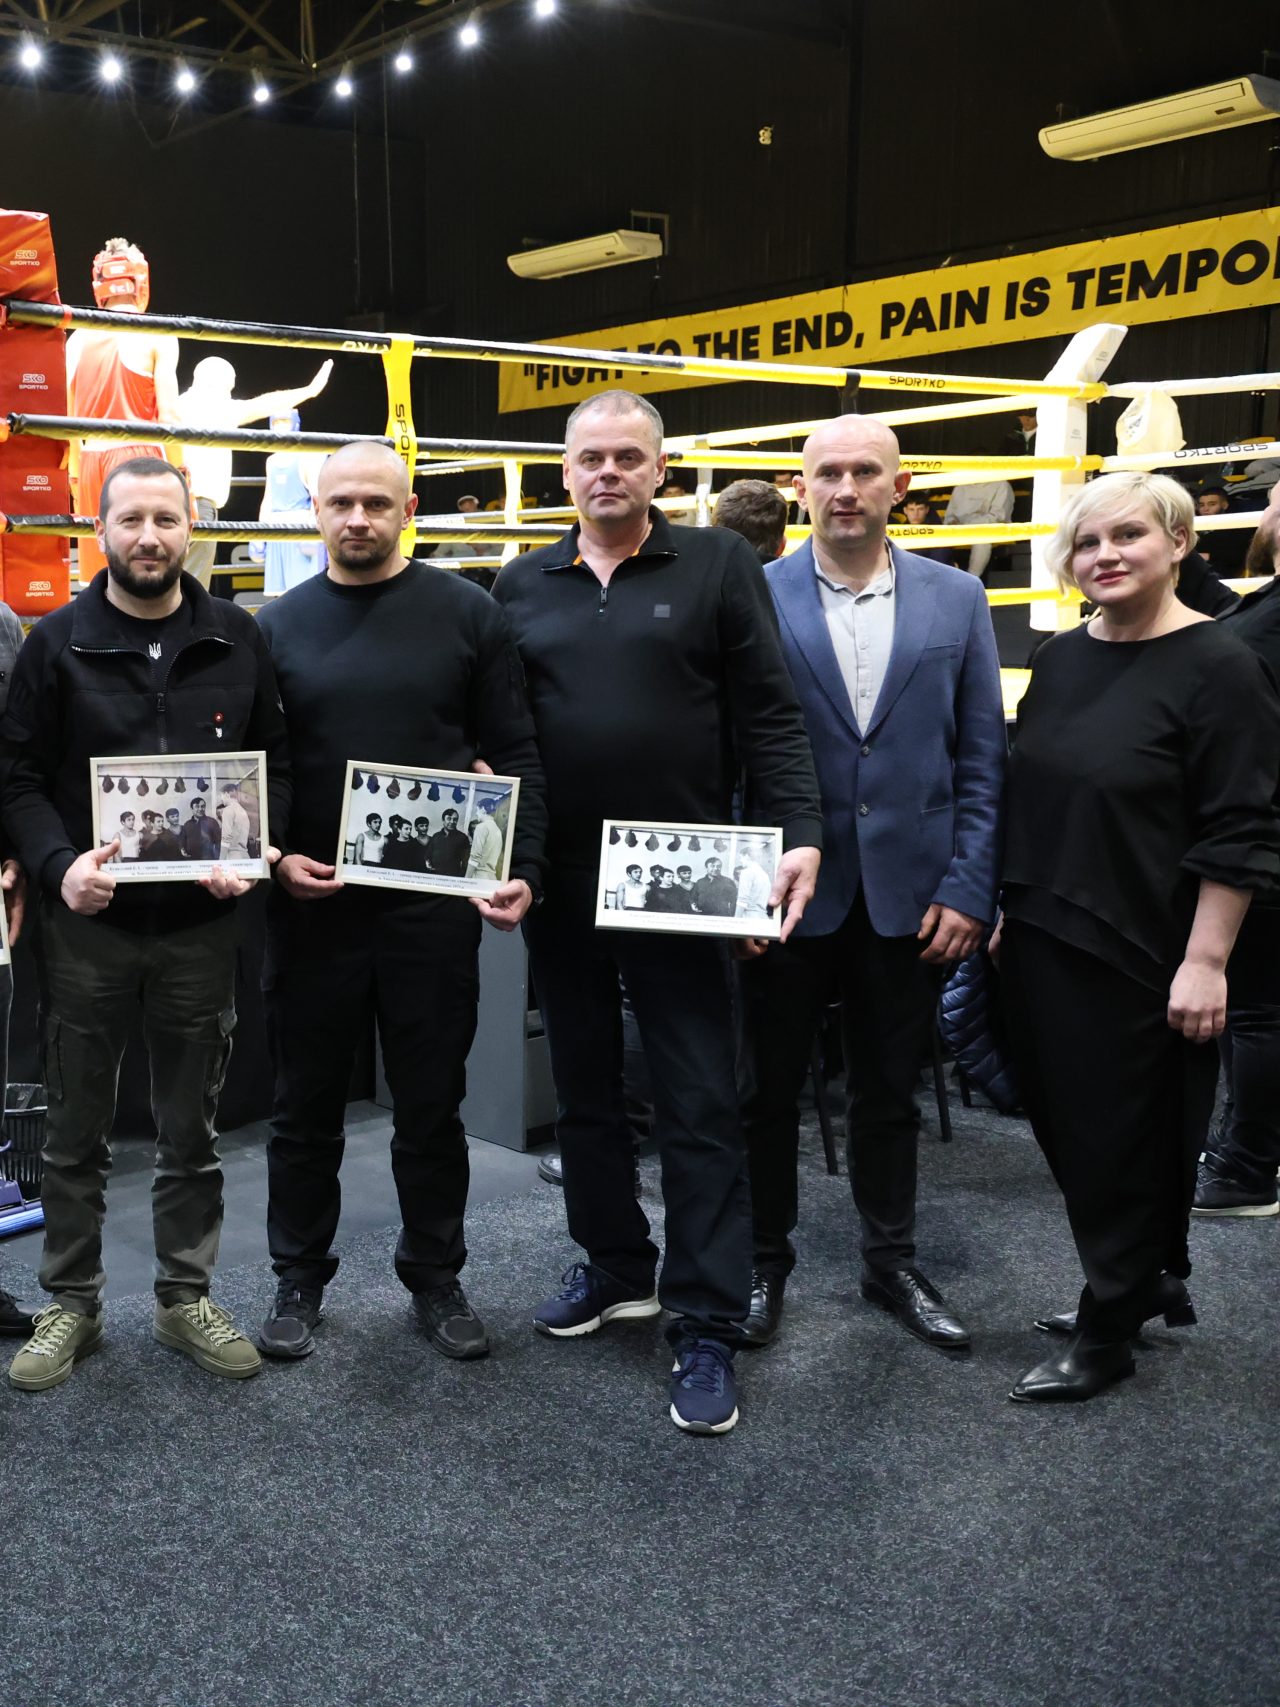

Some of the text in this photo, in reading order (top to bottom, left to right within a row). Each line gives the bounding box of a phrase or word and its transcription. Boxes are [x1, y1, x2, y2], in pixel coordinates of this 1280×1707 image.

[693, 325, 760, 362] THE
[773, 311, 864, 356] END,
[880, 285, 991, 340] PAIN
[1004, 276, 1051, 320] IS
[1067, 236, 1280, 310] TEMPO
[888, 375, 945, 388] SPORTKO
[1175, 443, 1268, 459] SPORTKO
[899, 461, 943, 469] ORTKO
